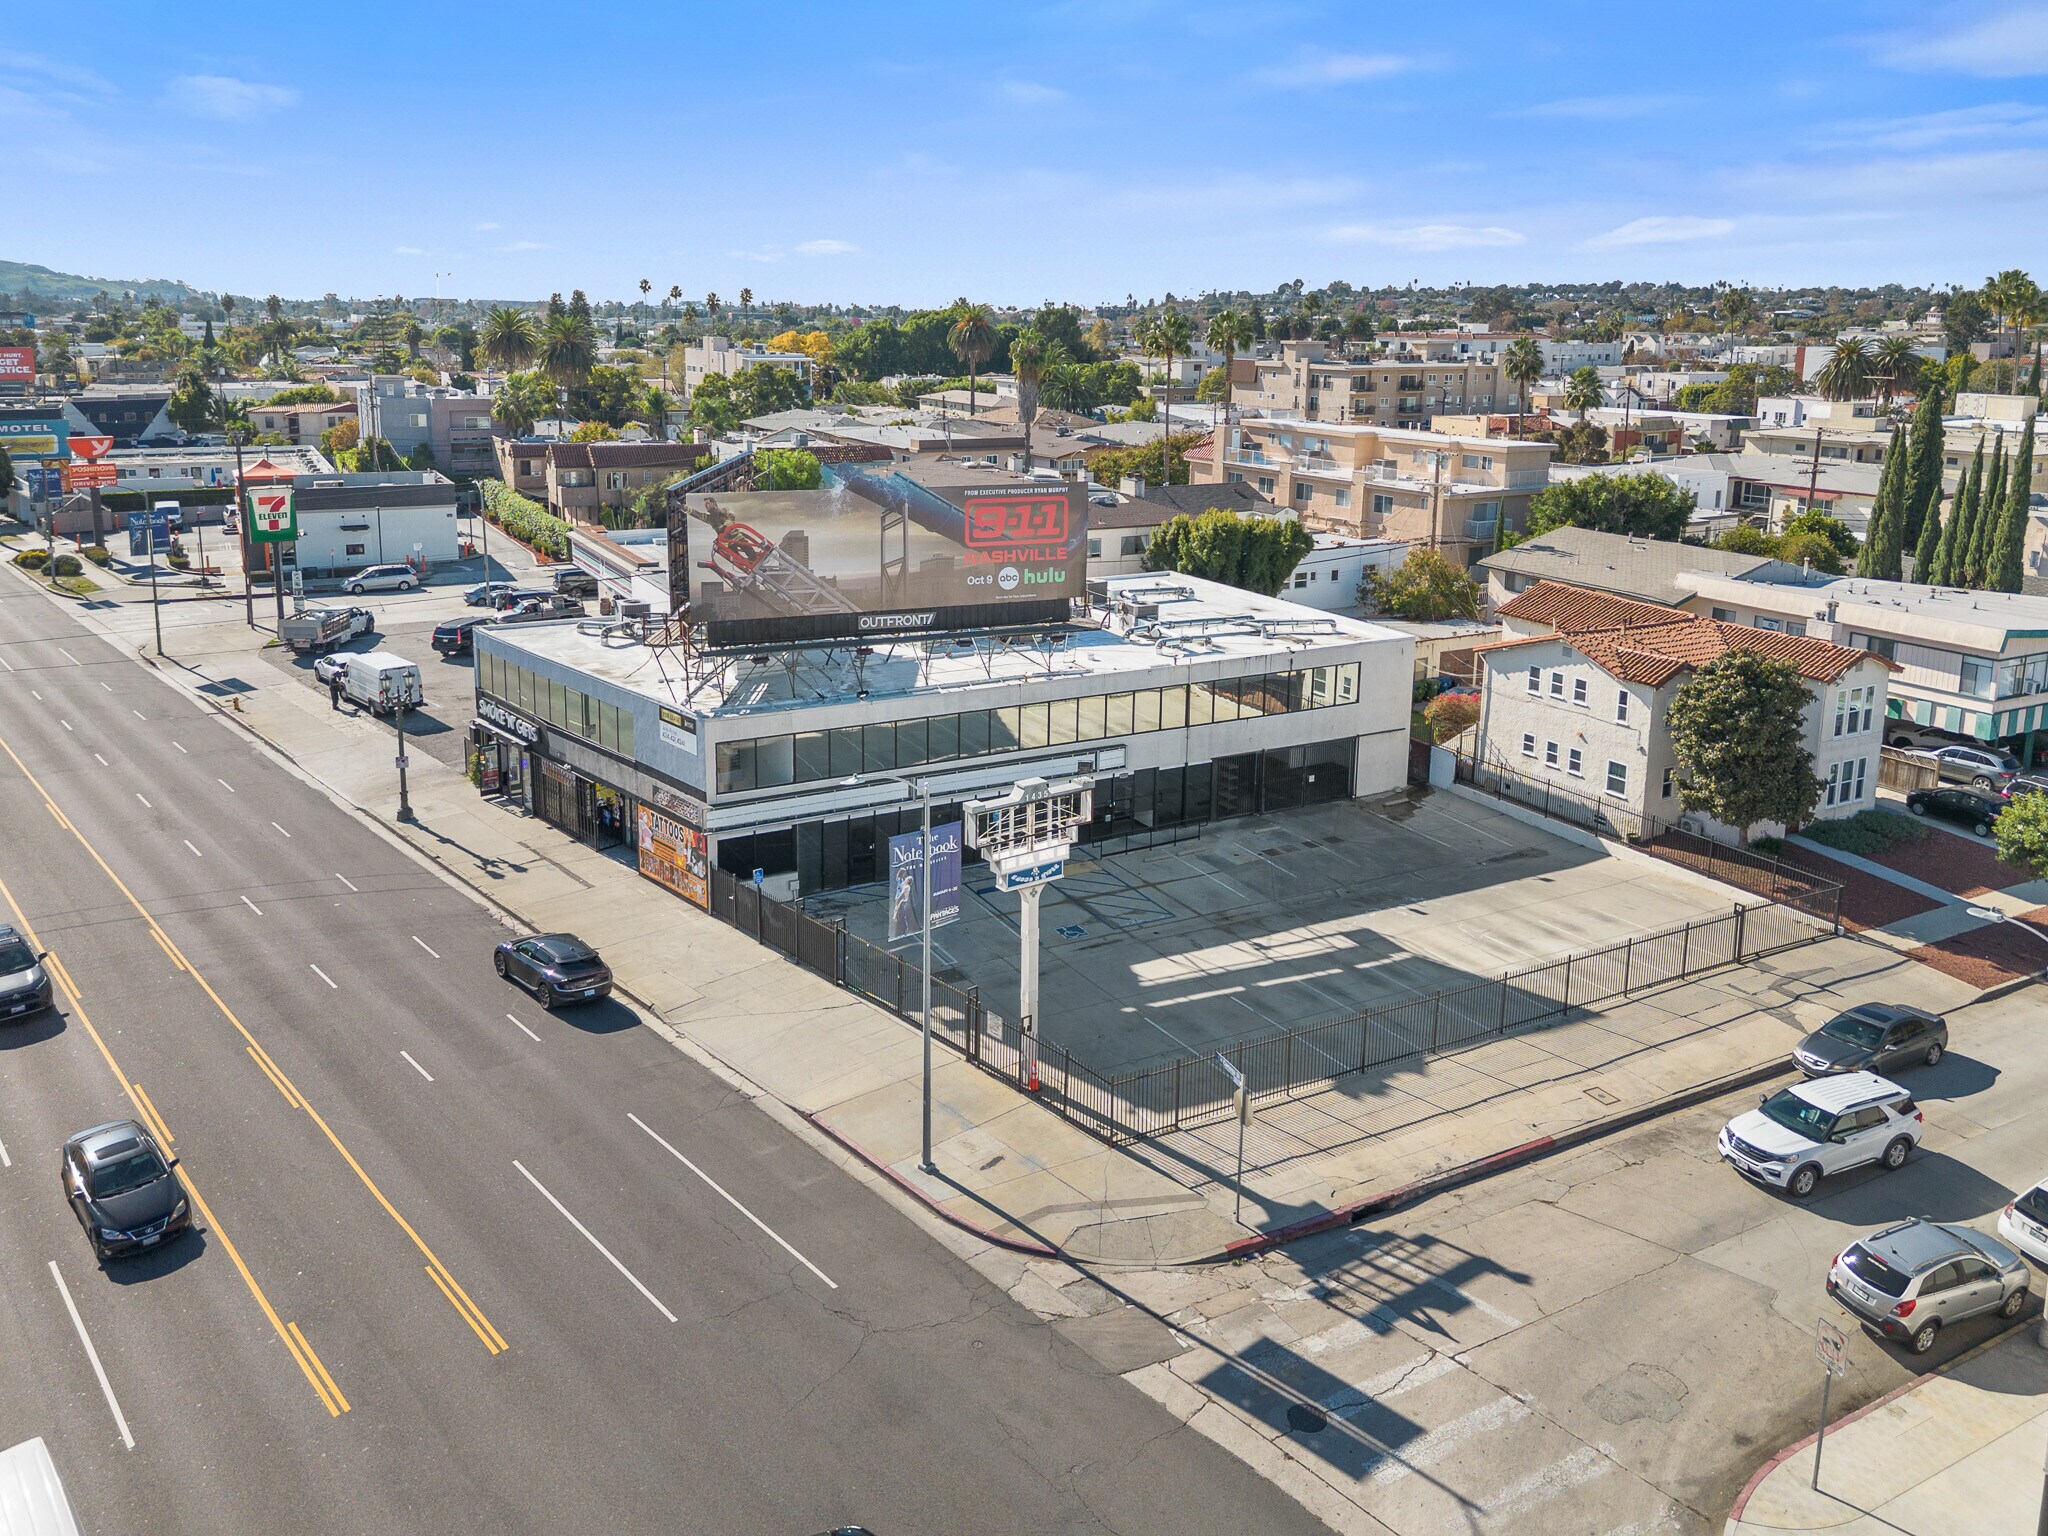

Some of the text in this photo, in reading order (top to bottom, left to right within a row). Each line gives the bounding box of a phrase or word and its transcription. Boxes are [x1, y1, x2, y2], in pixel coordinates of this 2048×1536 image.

[73, 479, 117, 487] DRIVE-THRU
[980, 488, 1007, 496] EXECUTIVE
[1007, 487, 1034, 495] PRODUCER
[257, 495, 286, 530] 7
[964, 547, 1068, 566] NASHVILLE
[967, 567, 1066, 586] Oct 9 abc hulu
[478, 699, 506, 726] SMOKE
[515, 719, 539, 742] GIFTS
[1025, 790, 1049, 802] 1435
[649, 812, 686, 843] TATTOOS
[892, 834, 959, 866] Notebook
